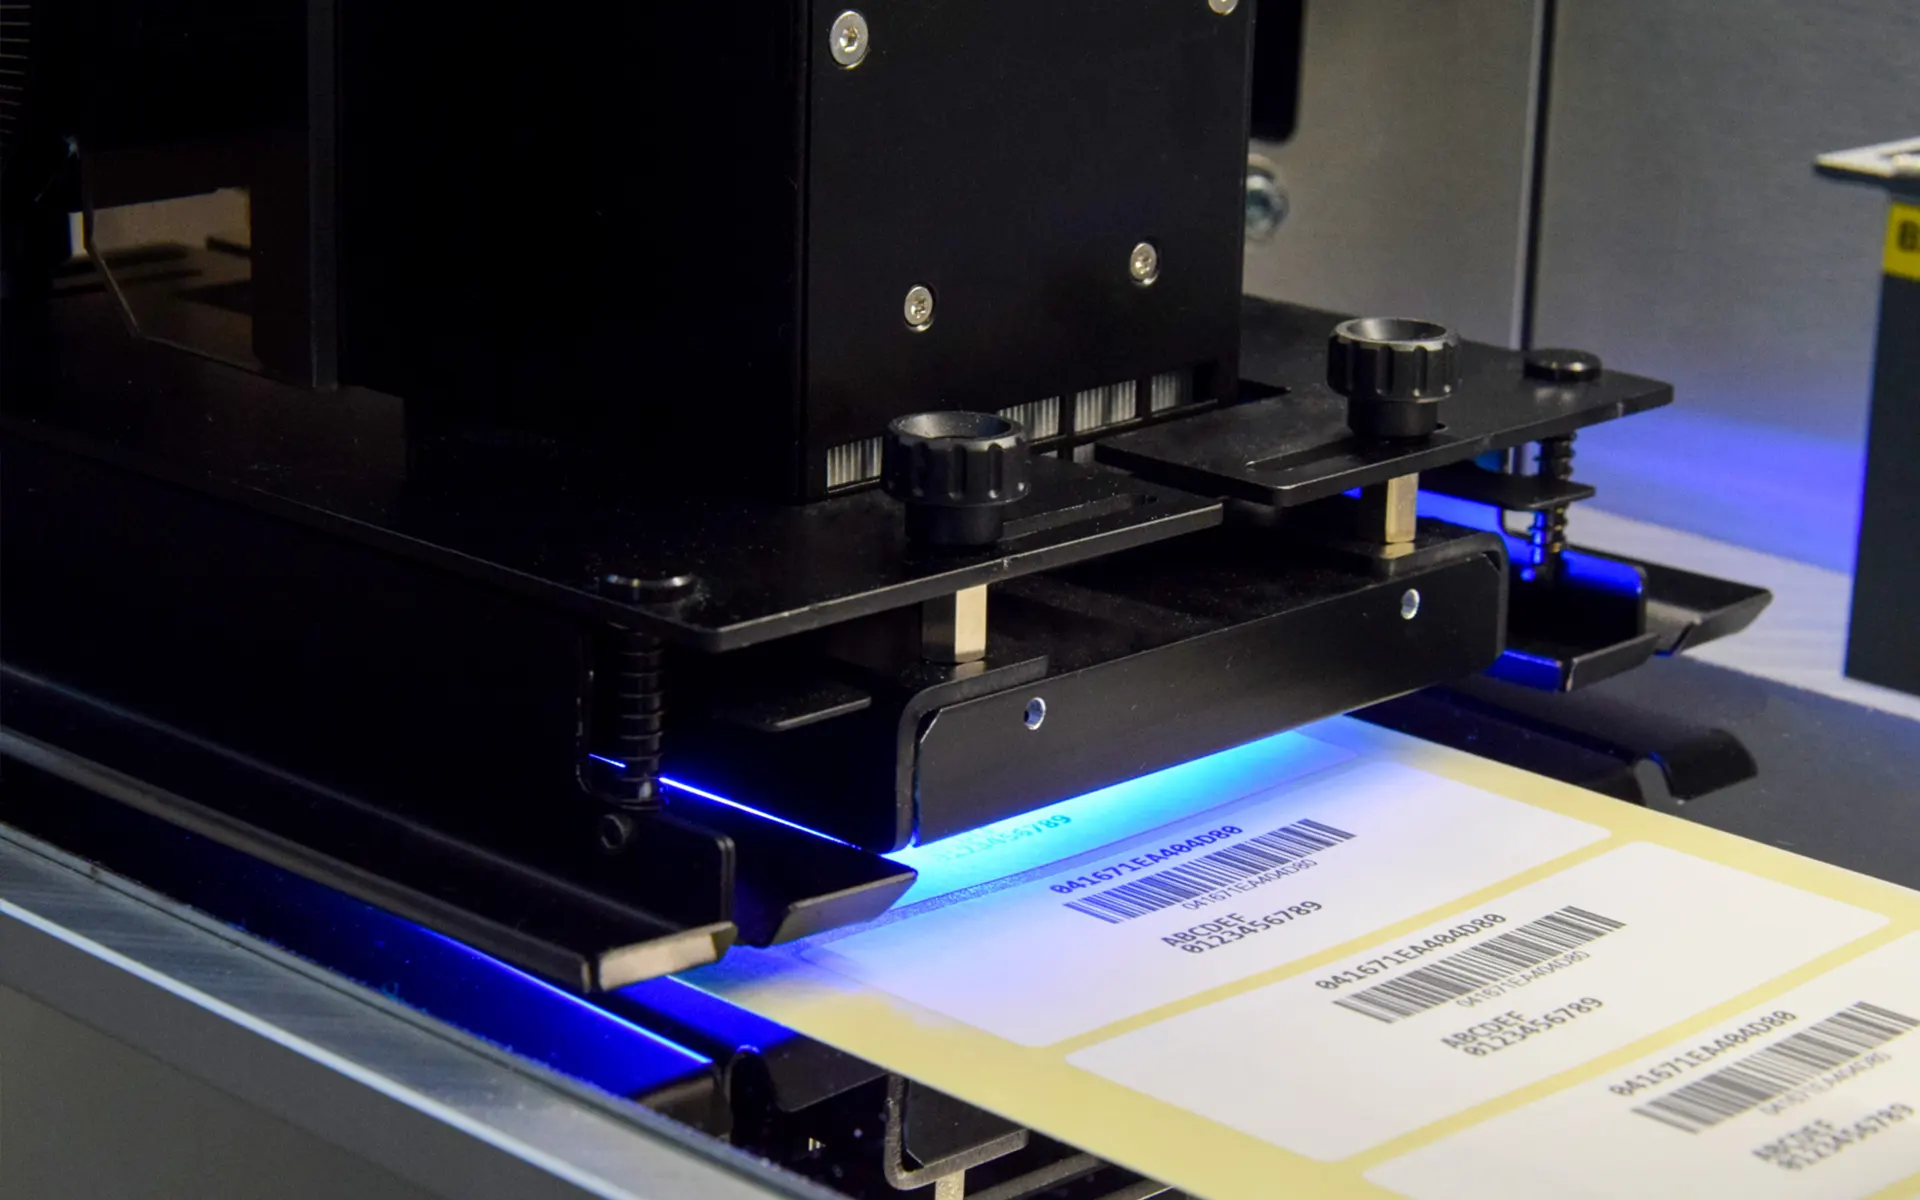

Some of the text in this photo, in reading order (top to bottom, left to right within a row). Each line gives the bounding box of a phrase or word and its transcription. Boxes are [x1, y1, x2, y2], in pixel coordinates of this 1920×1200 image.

[1049, 824, 1243, 895] 041671EA404D80
[1160, 911, 1249, 947] ABCDEF
[1180, 899, 1323, 954] 0123456789
[1314, 912, 1507, 991] 041671EA404D80
[1440, 1009, 1526, 1050] ABCDEF
[1462, 995, 1604, 1057] 0123456789
